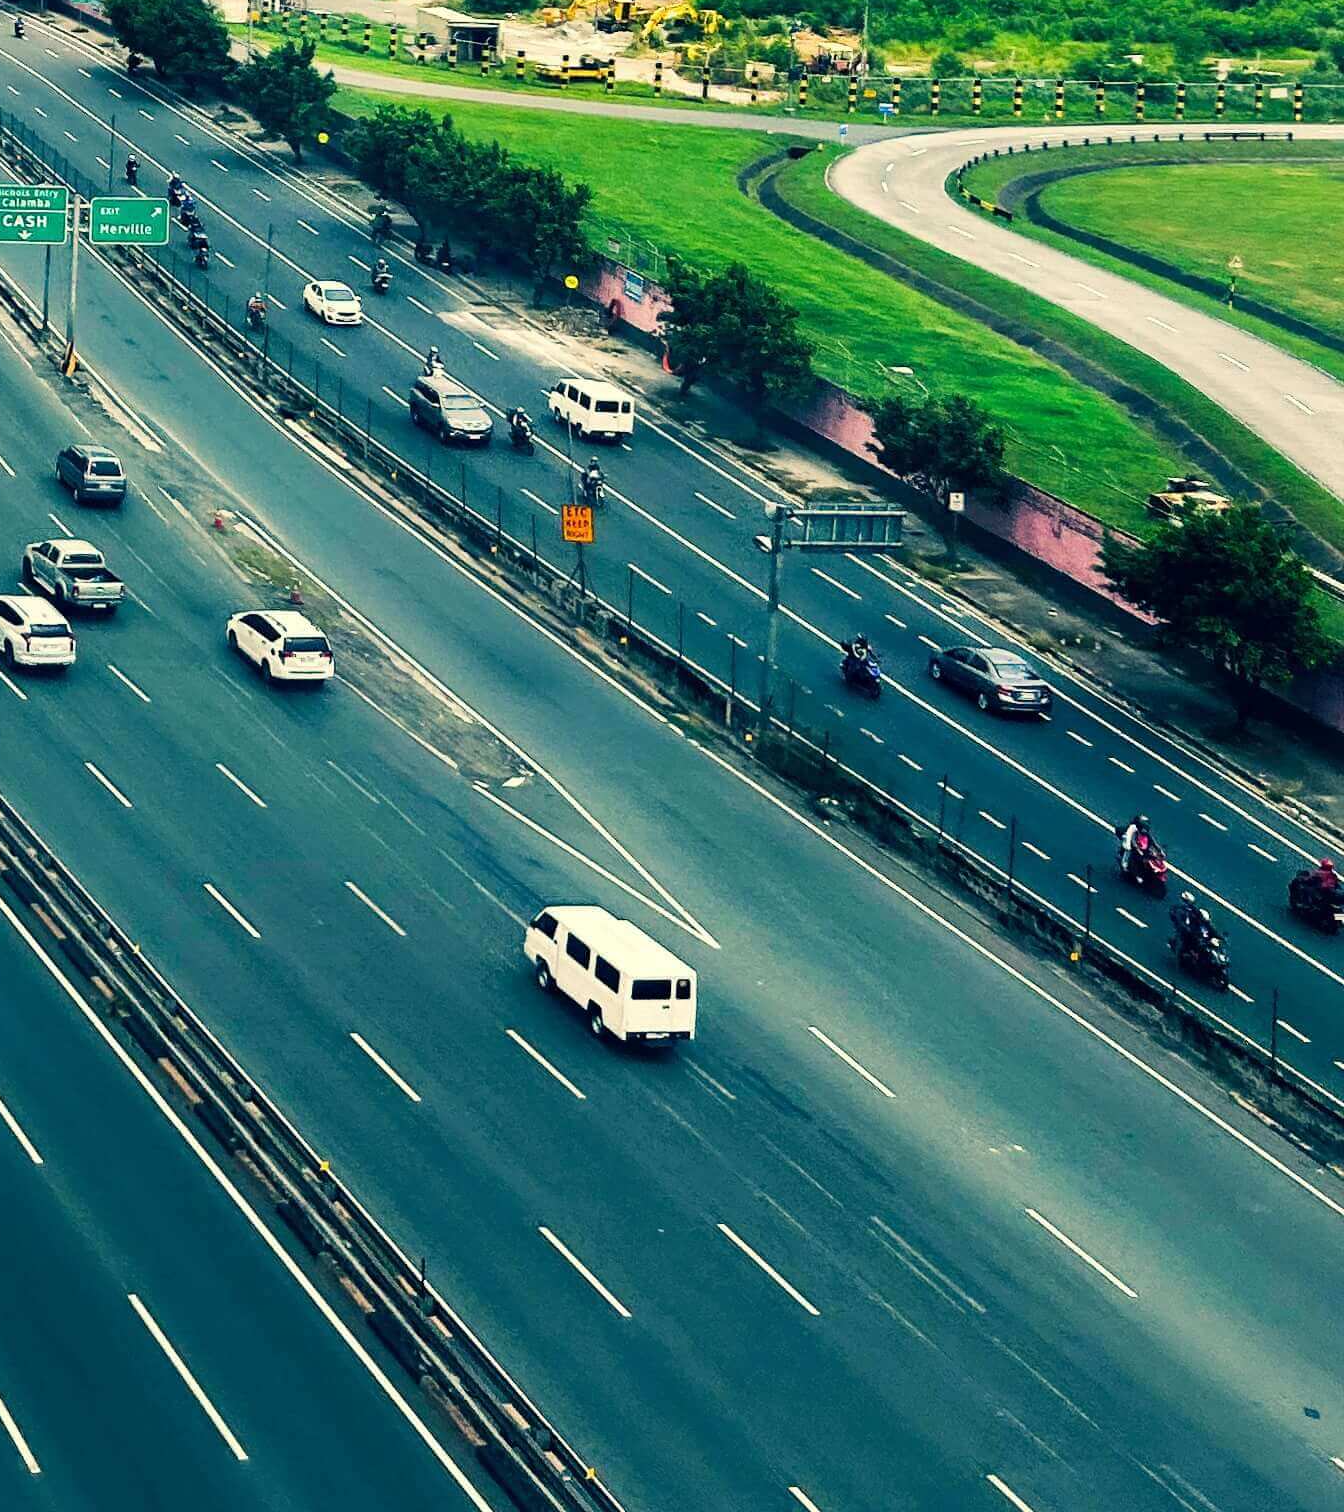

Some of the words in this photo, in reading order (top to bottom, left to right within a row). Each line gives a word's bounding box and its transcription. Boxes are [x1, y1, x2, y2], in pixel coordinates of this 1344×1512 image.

[34, 189, 59, 198] Entry
[2, 198, 51, 208] Calamba
[100, 207, 120, 215] EXIT
[2, 214, 48, 228] CASH
[99, 223, 153, 235] Merville
[567, 507, 587, 517] ETC
